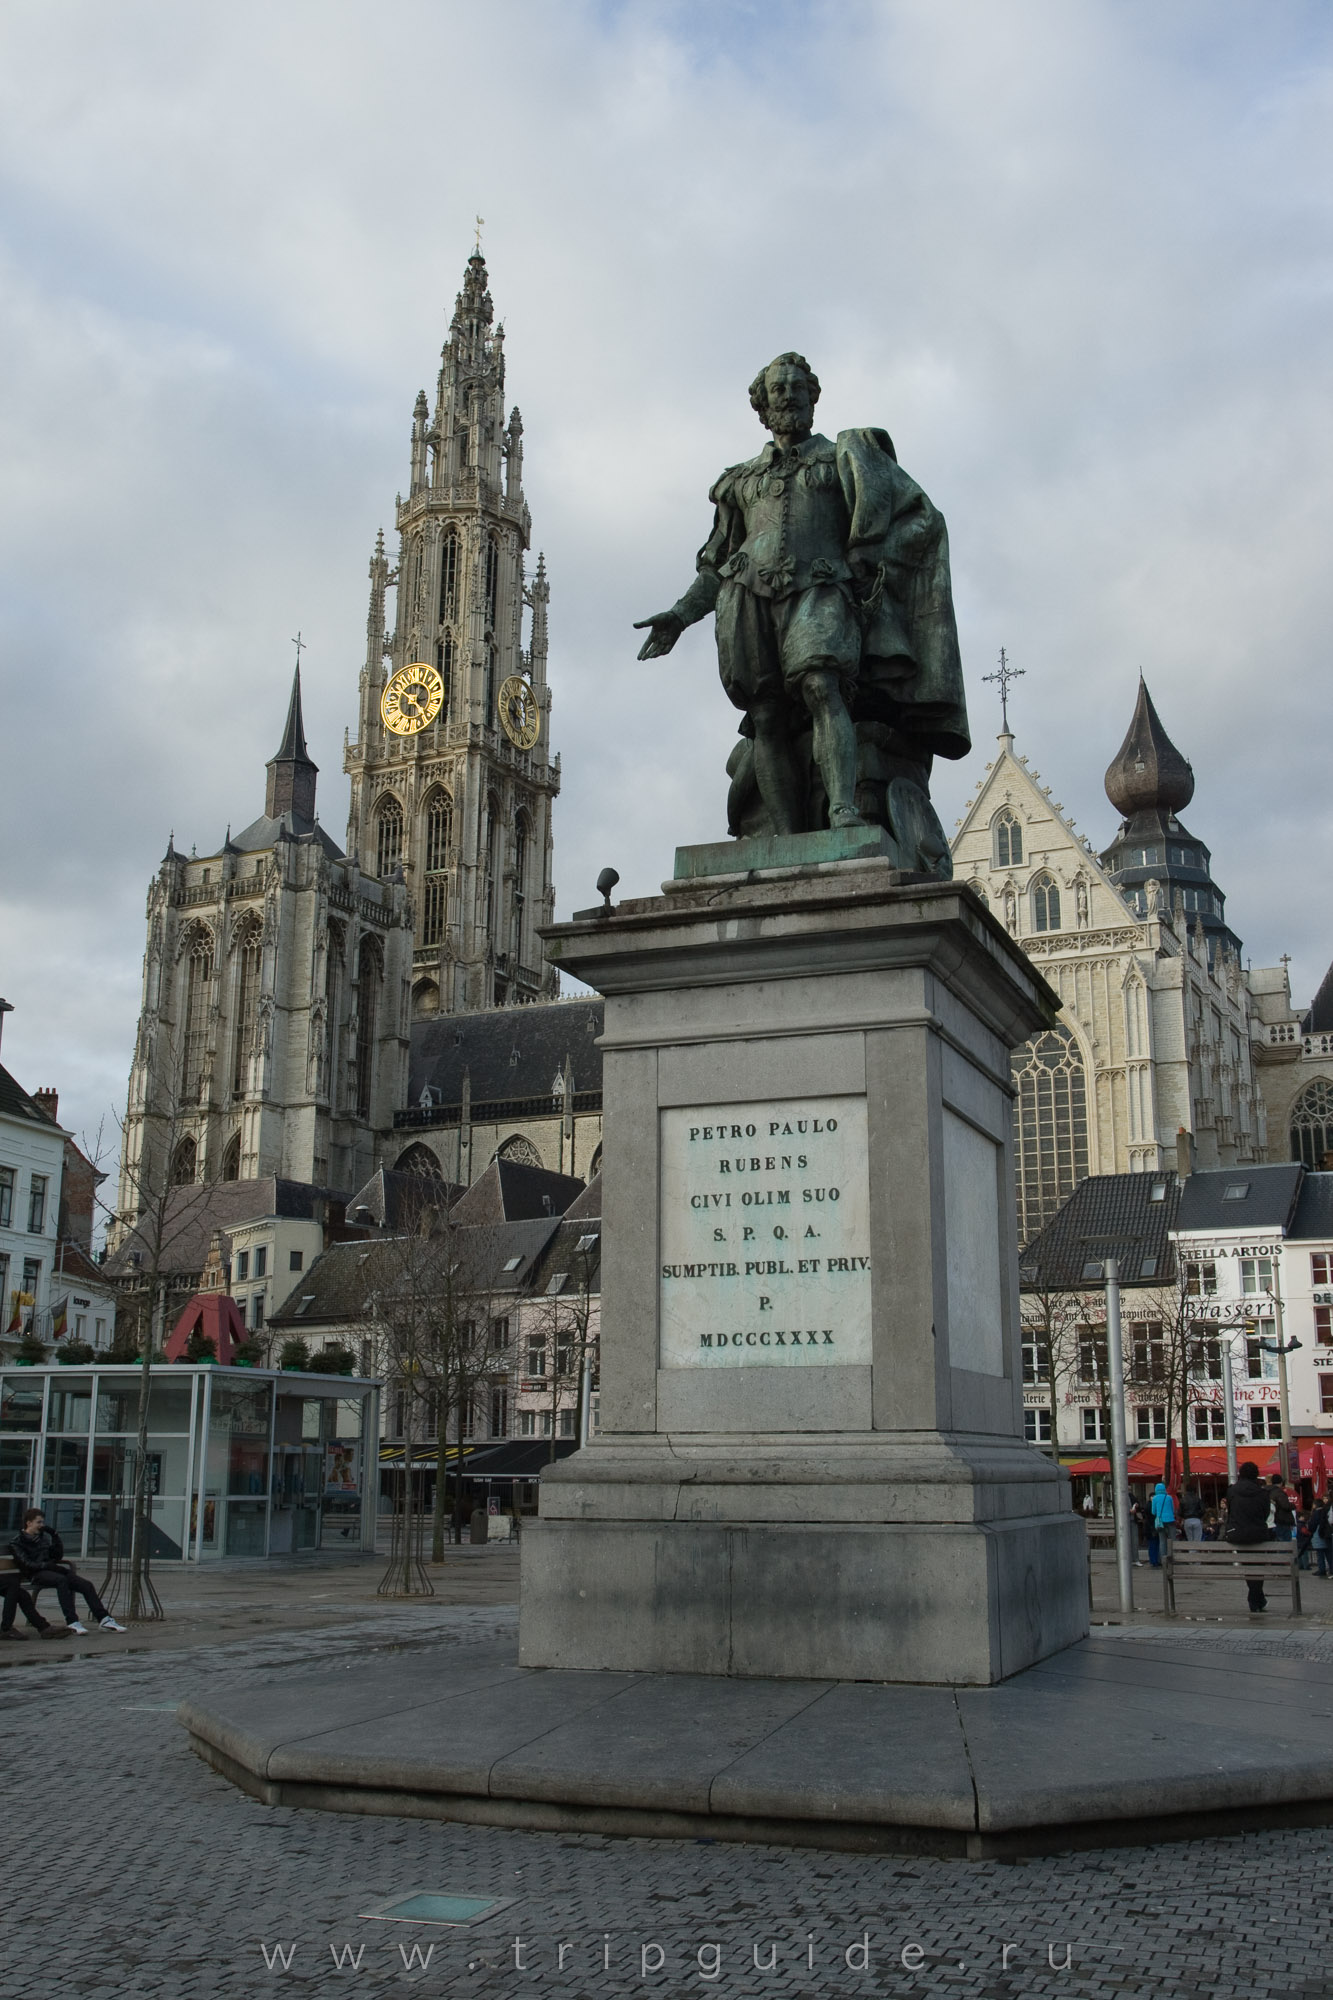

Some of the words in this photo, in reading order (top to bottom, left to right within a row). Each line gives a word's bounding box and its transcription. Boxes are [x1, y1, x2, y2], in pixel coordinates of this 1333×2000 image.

[689, 1123, 757, 1142] PETRO
[768, 1118, 838, 1137] PAULO
[718, 1154, 808, 1174] RUBENS
[690, 1193, 732, 1209] CIVI
[741, 1189, 791, 1206] OLIM
[802, 1187, 840, 1203] SUO
[713, 1227, 727, 1242] S.
[742, 1226, 756, 1241] P.
[772, 1225, 789, 1241] Q.
[803, 1224, 821, 1239] A.
[1180, 1248, 1228, 1260] STELLA
[1231, 1244, 1283, 1257] ARTOIS
[662, 1261, 740, 1279] SUMPTIB.
[744, 1260, 794, 1276] PUBL.
[797, 1259, 821, 1274] ET
[826, 1256, 872, 1272] PRIV.
[759, 1296, 773, 1311] P.
[700, 1329, 835, 1348] MDCCCXXXX
[1209, 1386, 1255, 1401] Kine
